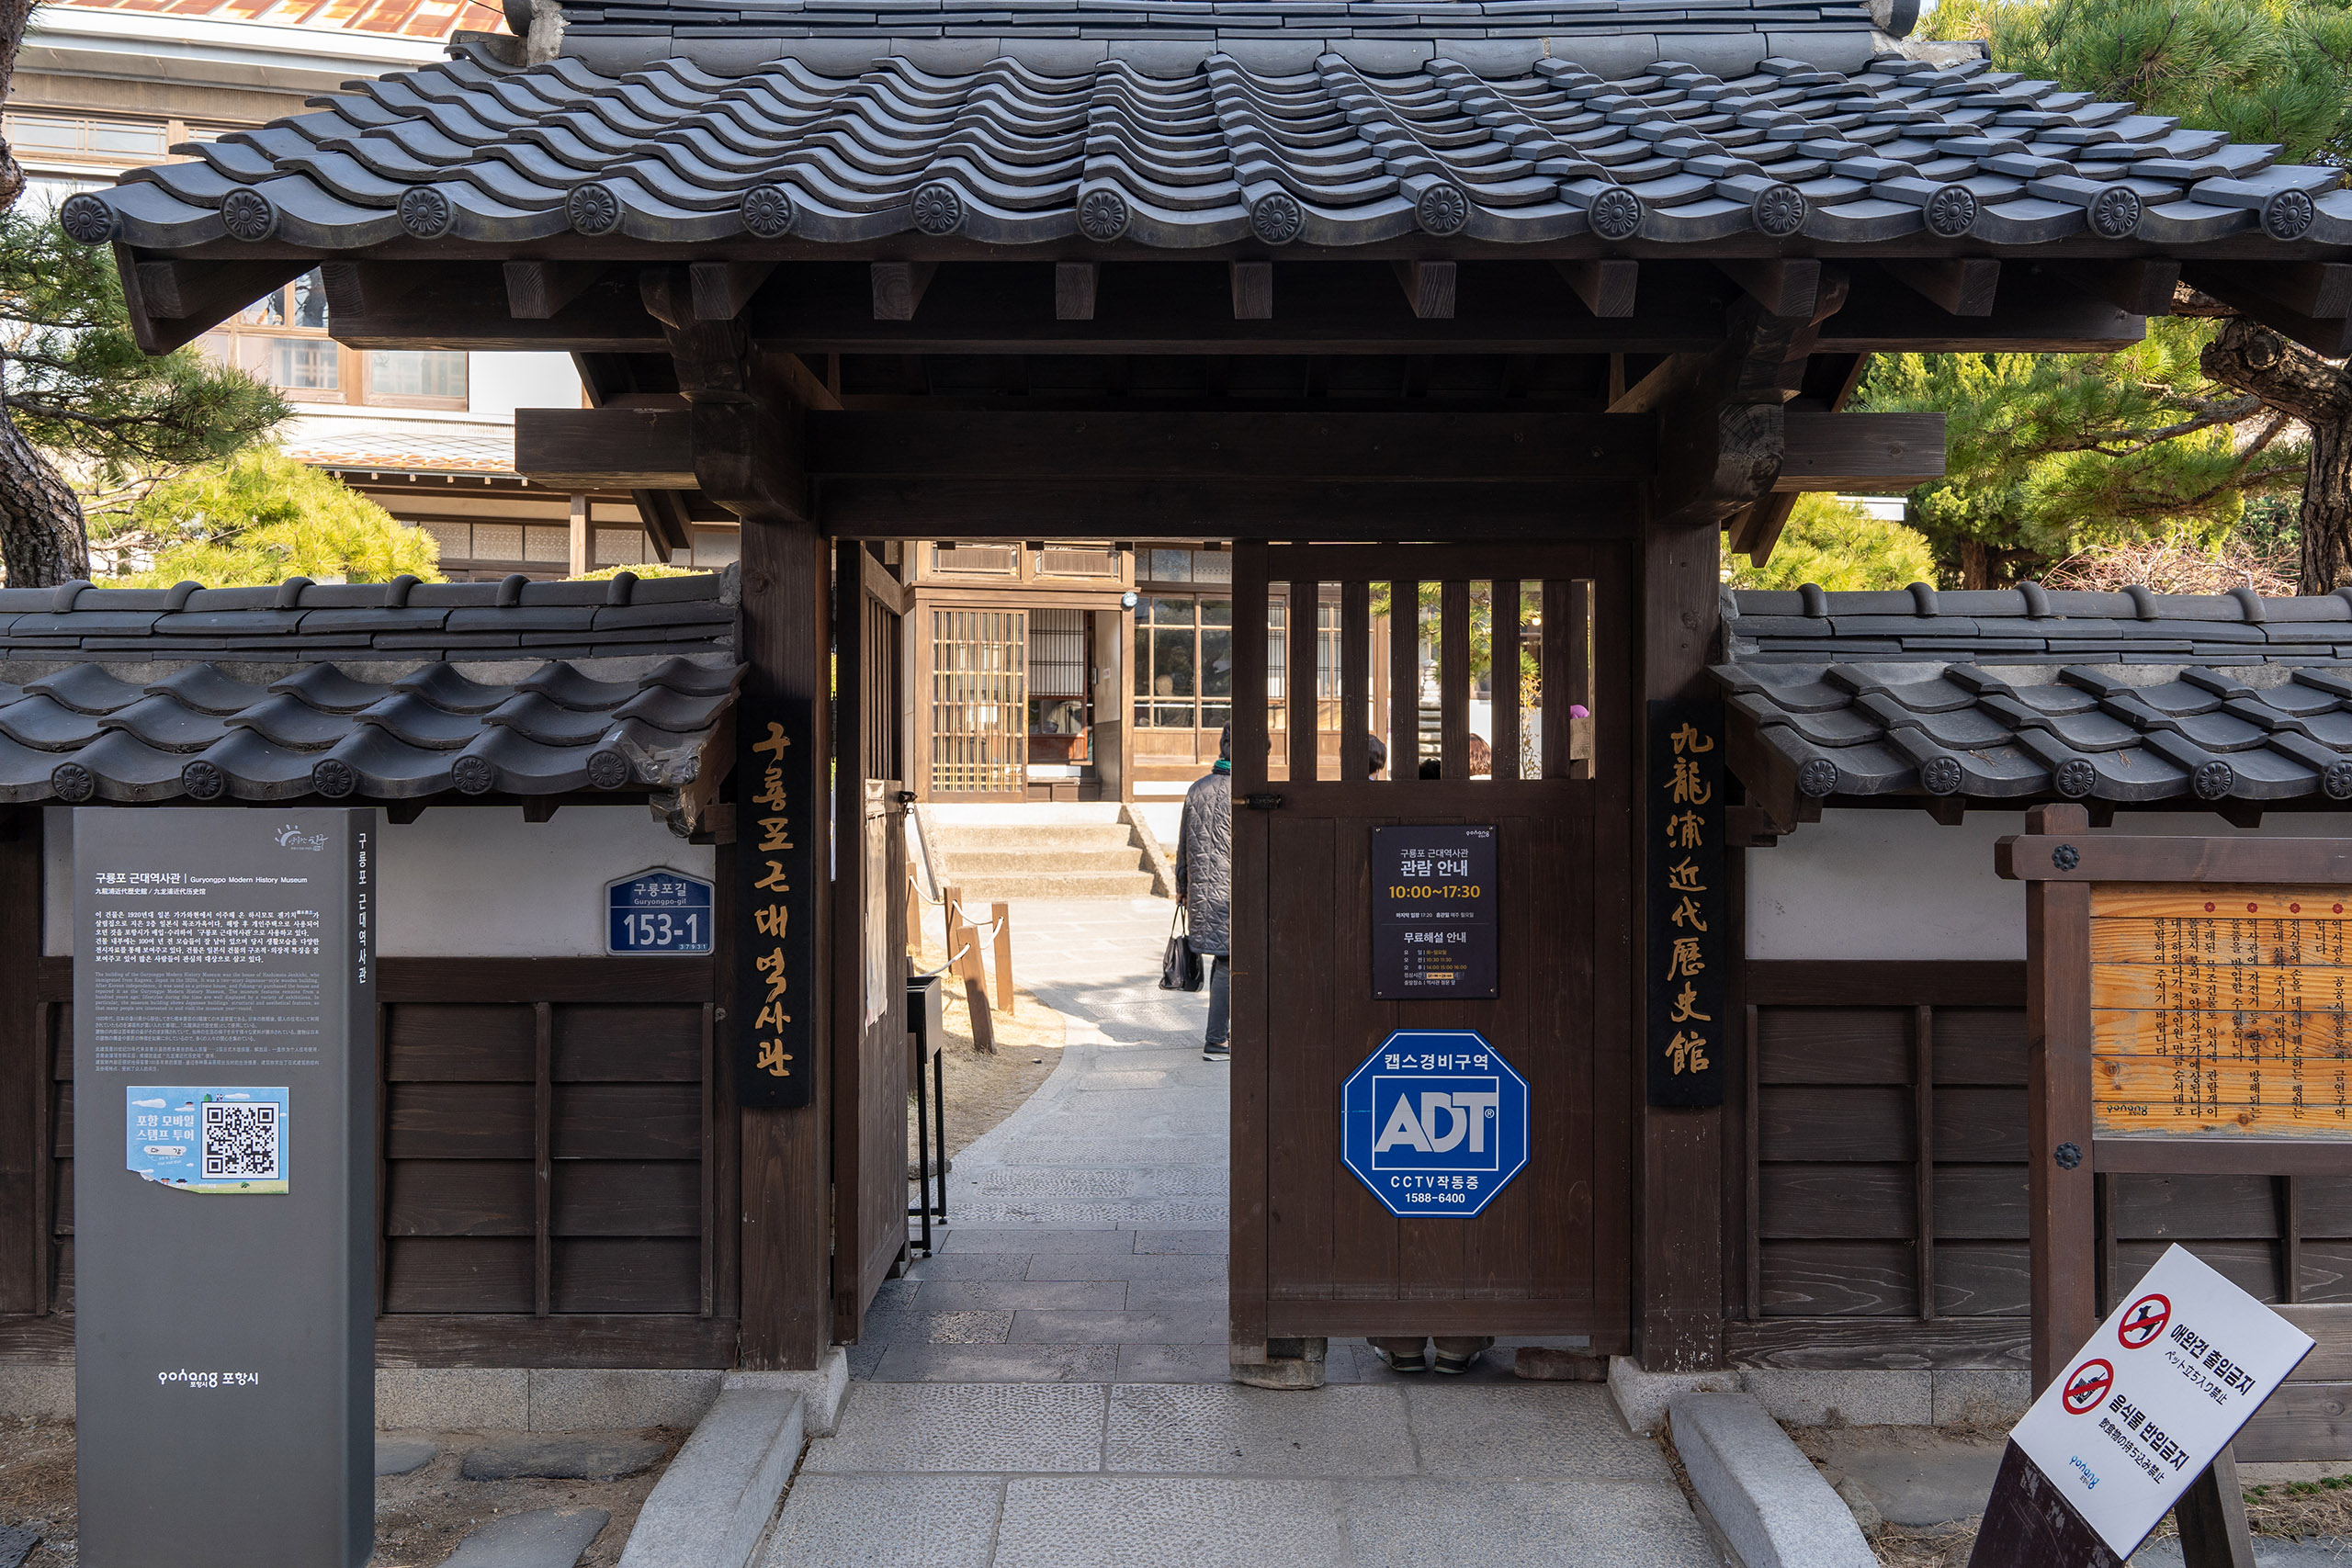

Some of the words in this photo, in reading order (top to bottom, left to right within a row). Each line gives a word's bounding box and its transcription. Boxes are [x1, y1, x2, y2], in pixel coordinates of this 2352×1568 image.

[358, 832, 368, 886] 구룡포
[1400, 849, 1425, 858] 구룡포
[1427, 849, 1468, 858] 근대역사관
[1400, 860, 1432, 876] 관람
[1437, 859, 1468, 876] 안내
[96, 873, 127, 885] 구룡포
[130, 873, 181, 885] 근대역사관
[190, 876, 226, 885] Guryongpo
[634, 883, 687, 897] 구룡포길
[1388, 886, 1481, 898] 10:00~17:30
[634, 898, 687, 907] Guryongpo-gil
[358, 893, 368, 985] 근대역사관
[623, 913, 697, 946] 153-1
[1404, 931, 1443, 943] 무료해설
[1446, 931, 1466, 943] 안내
[2154, 919, 2166, 964] 관람하여
[2205, 919, 2216, 953] 오래된
[2315, 920, 2327, 954] 입니다
[2154, 969, 2167, 1005] 주시기
[2188, 983, 2201, 995] 등
[2247, 971, 2260, 1008] 자전거
[2273, 976, 2286, 1010] 주시기
[2290, 969, 2303, 992] 손을
[2155, 1010, 2168, 1056] 바랍니다
[1385, 1054, 1488, 1071] 캡스경비구역
[2334, 1070, 2347, 1120] 금연구역
[136, 1114, 158, 1126] 포항
[161, 1114, 195, 1126] 모바일
[136, 1129, 169, 1141] 스탬프
[172, 1129, 195, 1141] 투어
[1374, 1091, 1498, 1153] ADT
[1405, 1192, 1465, 1203] 1588-6400
[2170, 1324, 2211, 1359] 애완견
[2202, 1349, 2256, 1396] 출입금지
[221, 1371, 259, 1386] 포항시
[2165, 1350, 2228, 1405] ペット立ち入り禁止
[2109, 1394, 2146, 1431] 음식물
[2139, 1421, 2190, 1472] 반입금지
